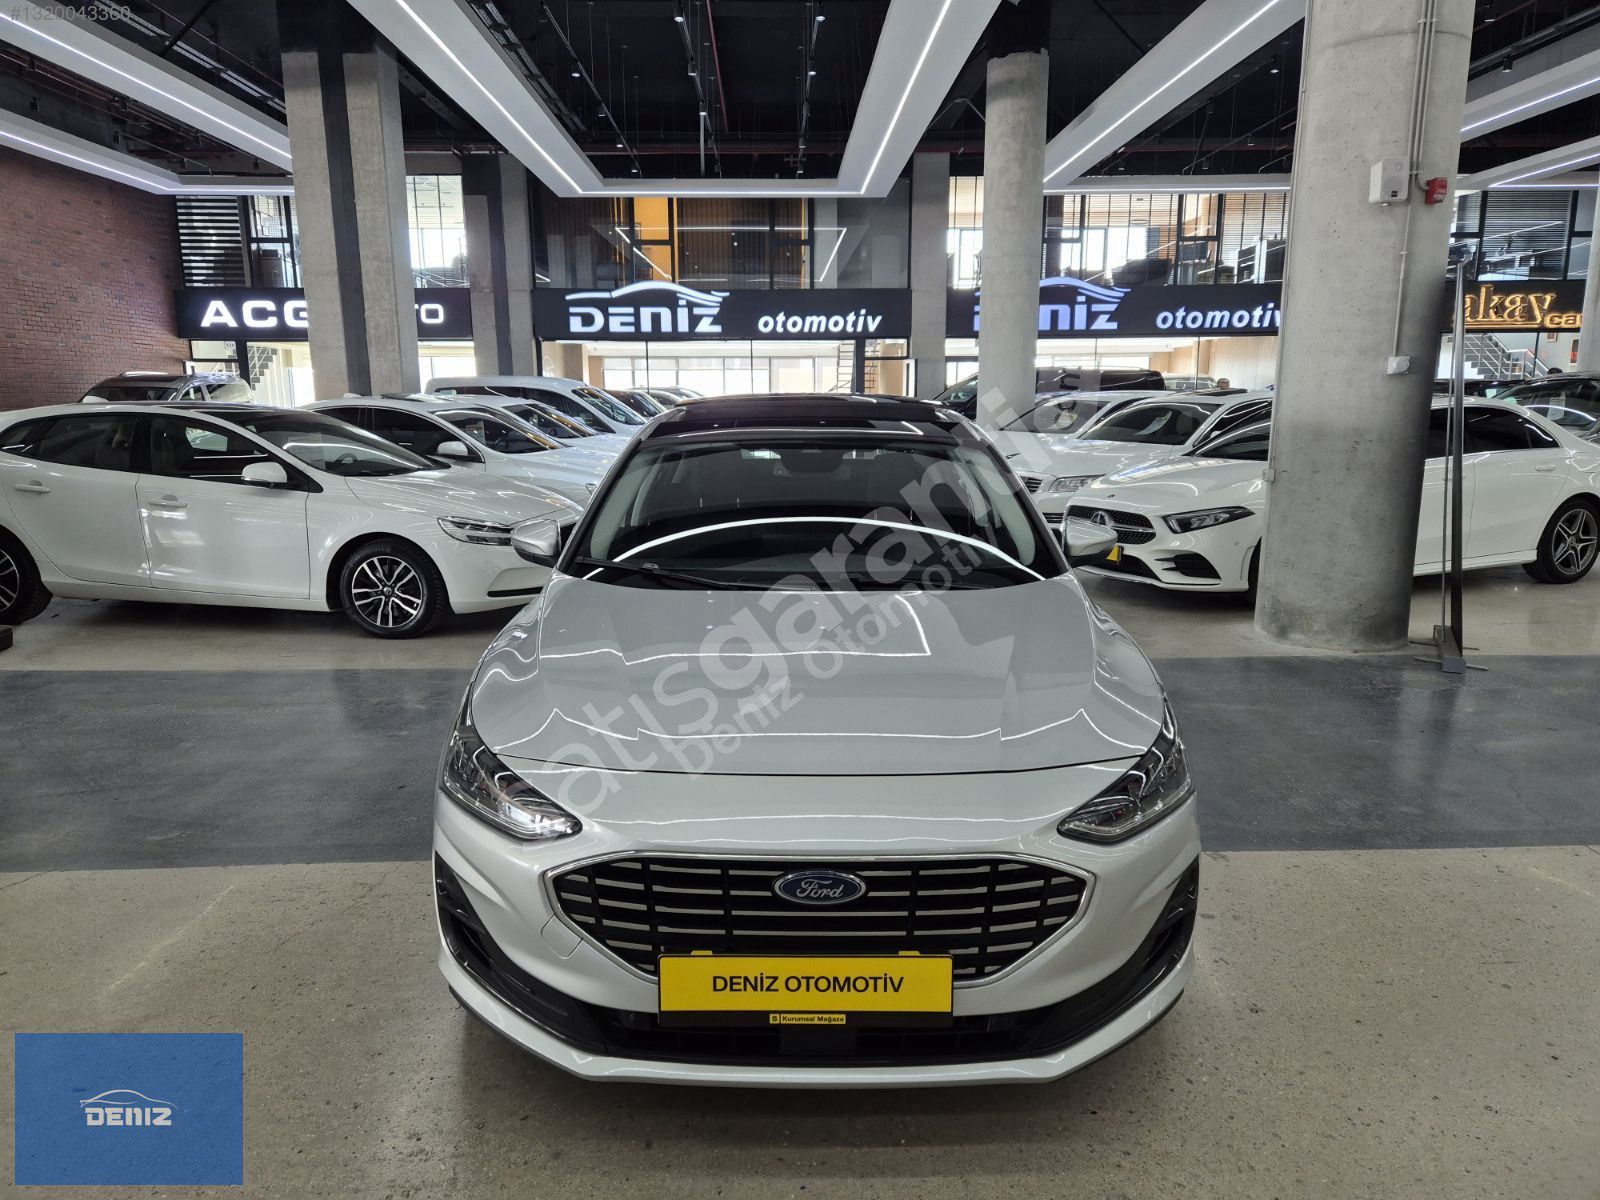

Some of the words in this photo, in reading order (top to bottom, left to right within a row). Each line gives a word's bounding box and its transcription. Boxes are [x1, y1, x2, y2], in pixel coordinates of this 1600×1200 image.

[757, 309, 882, 333] otomotiv
[796, 878, 844, 899] Ford
[712, 972, 779, 993] DENİZ
[784, 972, 904, 993] OTOMOTİV
[817, 1015, 844, 1023] Mağaza
